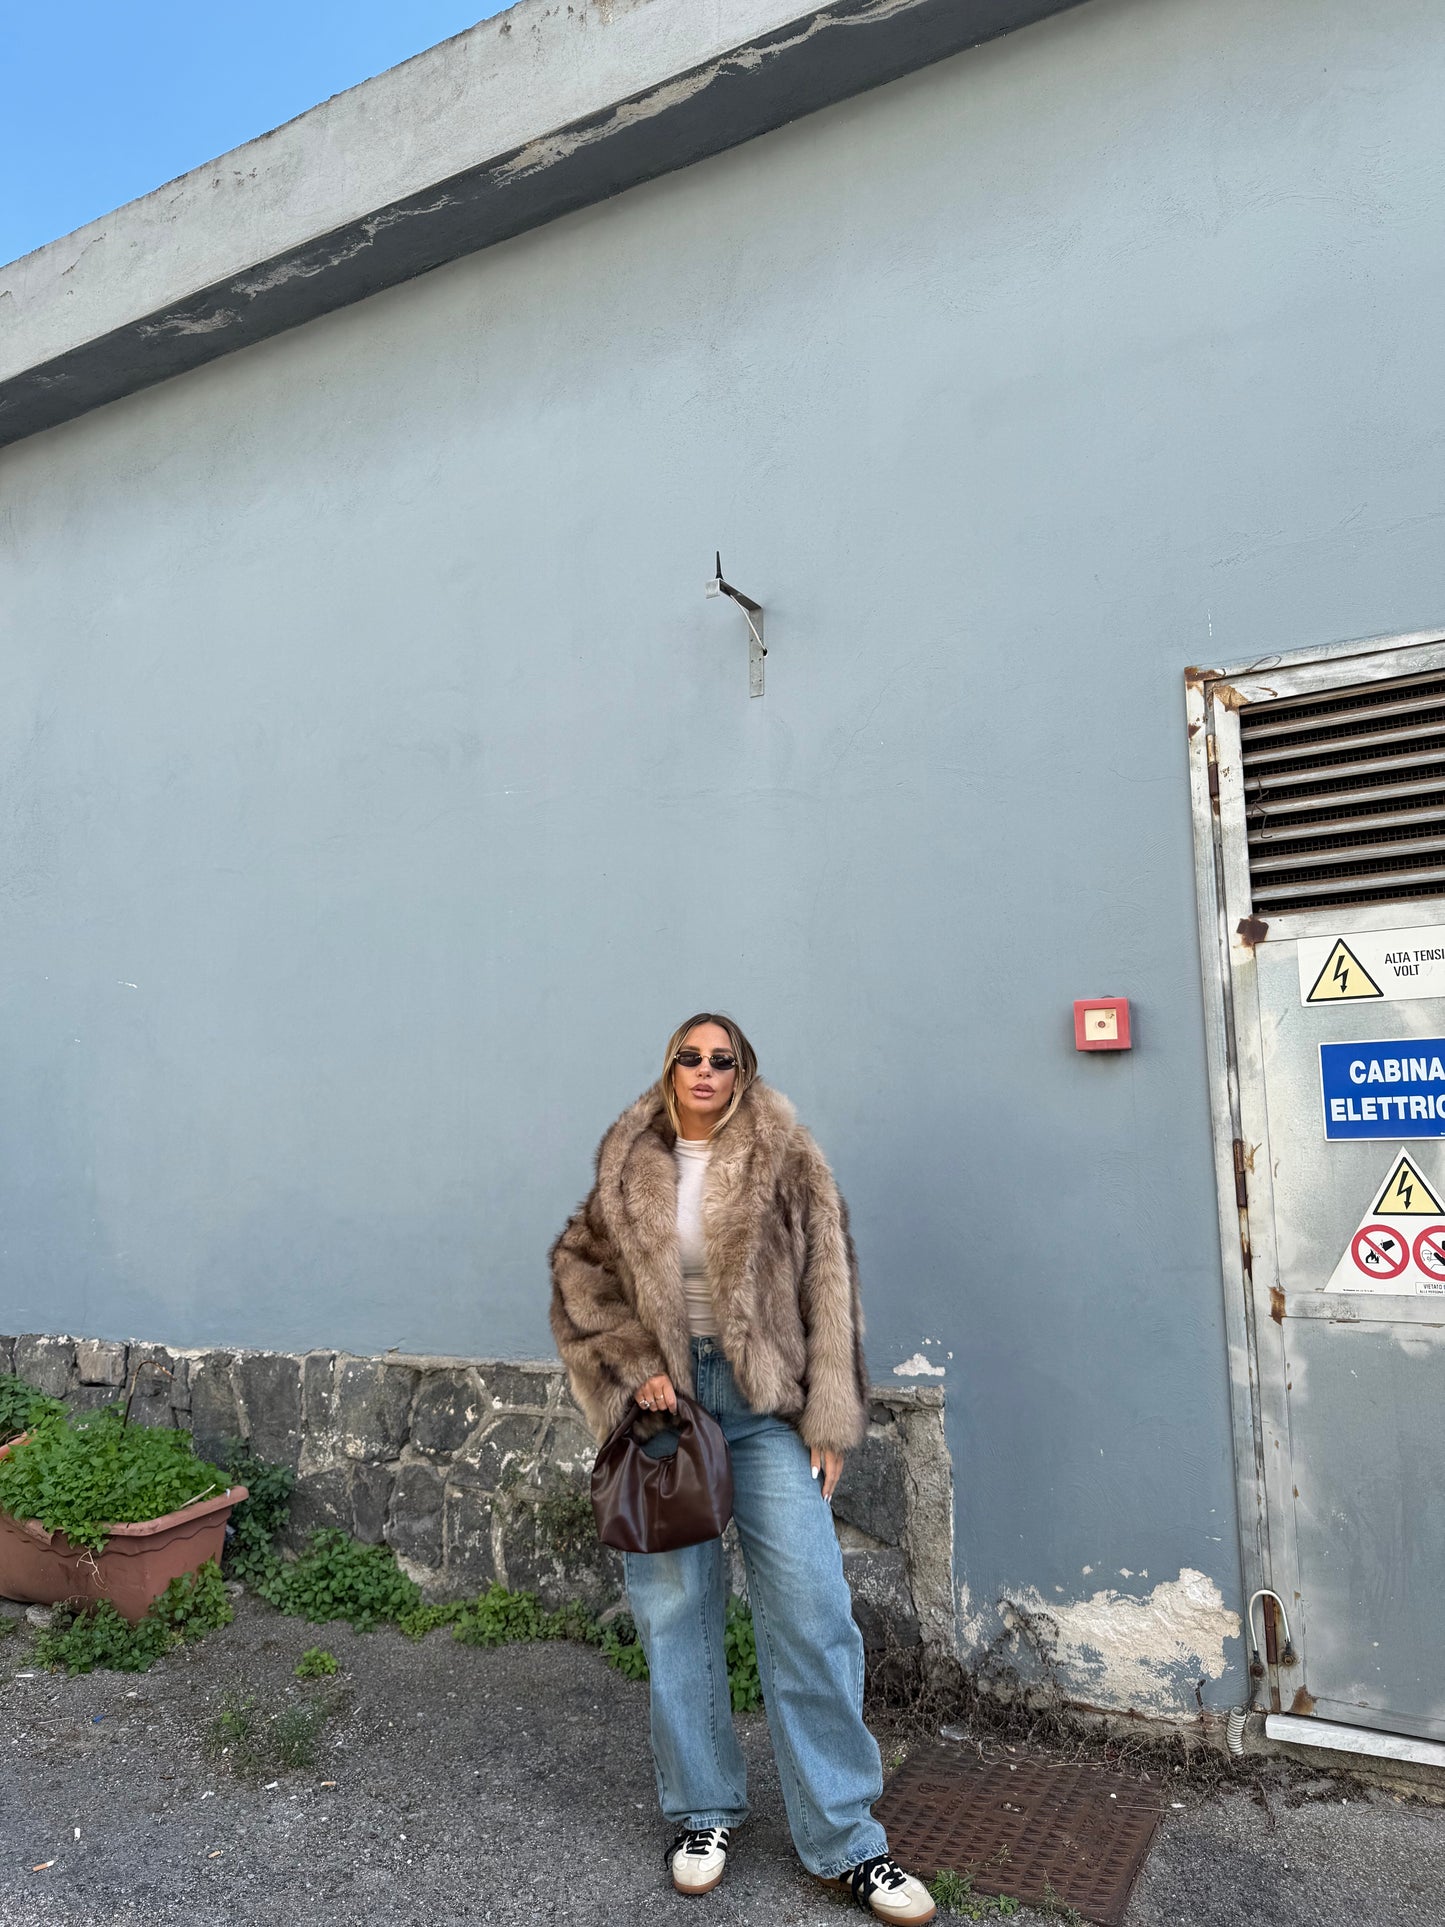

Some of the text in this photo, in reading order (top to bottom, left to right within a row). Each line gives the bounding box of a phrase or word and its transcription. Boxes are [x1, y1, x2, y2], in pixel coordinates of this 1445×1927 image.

[1385, 948, 1445, 964] ALTA TENSI
[1393, 964, 1420, 977] VOLT
[1349, 1057, 1445, 1084] CABINA
